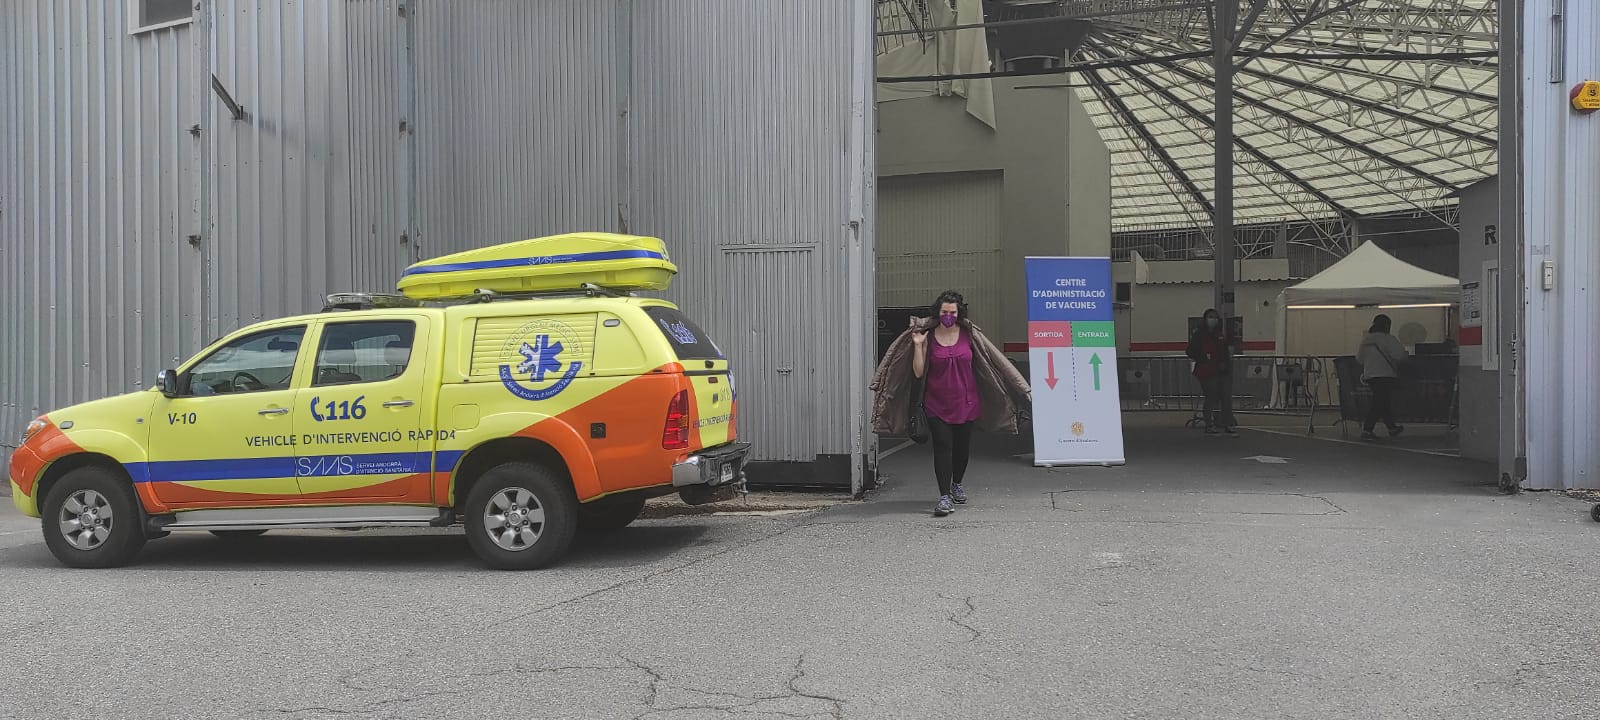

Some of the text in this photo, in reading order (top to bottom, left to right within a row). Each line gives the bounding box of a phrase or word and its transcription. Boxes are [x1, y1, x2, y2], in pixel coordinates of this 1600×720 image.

[1055, 278, 1087, 287] CENTRE
[1032, 288, 1106, 298] D'ADMINISTRACIÓ
[1045, 301, 1097, 310] DE VACUNES
[325, 395, 367, 421] 116
[167, 412, 198, 425] V-10
[245, 433, 297, 448] VEHICLE
[303, 428, 402, 445] D'INTERVENCIÓ
